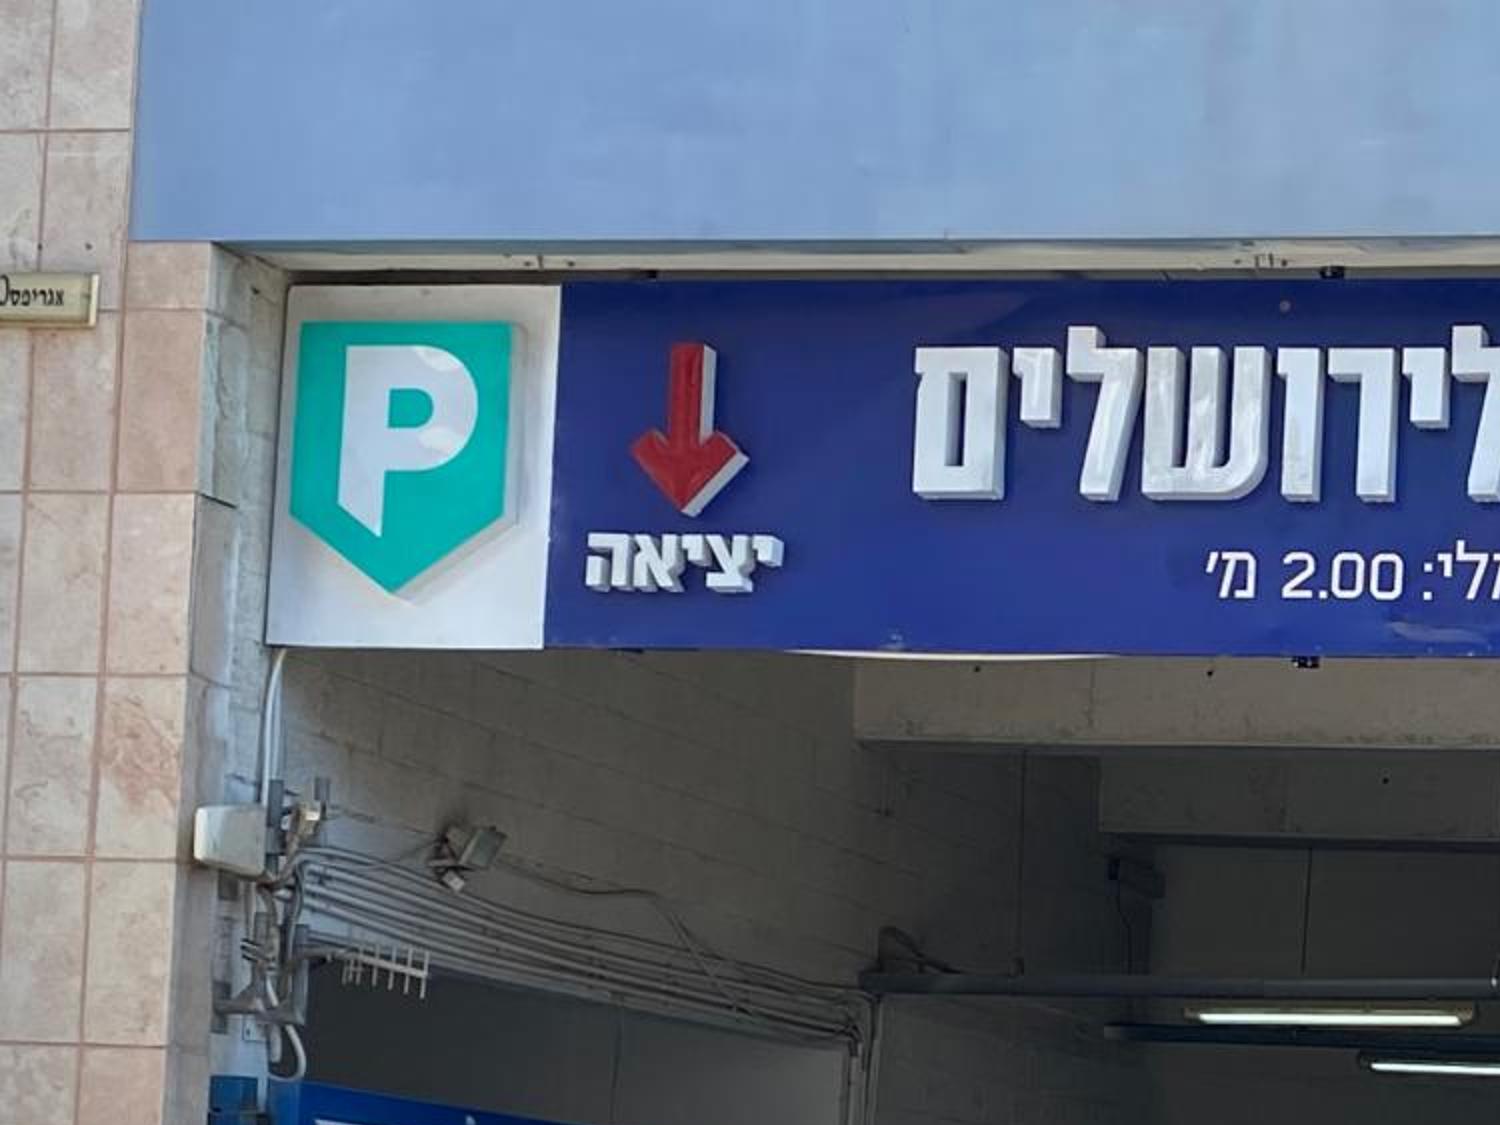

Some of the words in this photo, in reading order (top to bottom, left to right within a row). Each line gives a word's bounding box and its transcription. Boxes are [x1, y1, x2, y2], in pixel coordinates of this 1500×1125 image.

[10, 287, 64, 306] אגריפס
[337, 344, 479, 538] P
[585, 532, 784, 593] יציאה
[1280, 551, 1404, 600] 2.00
